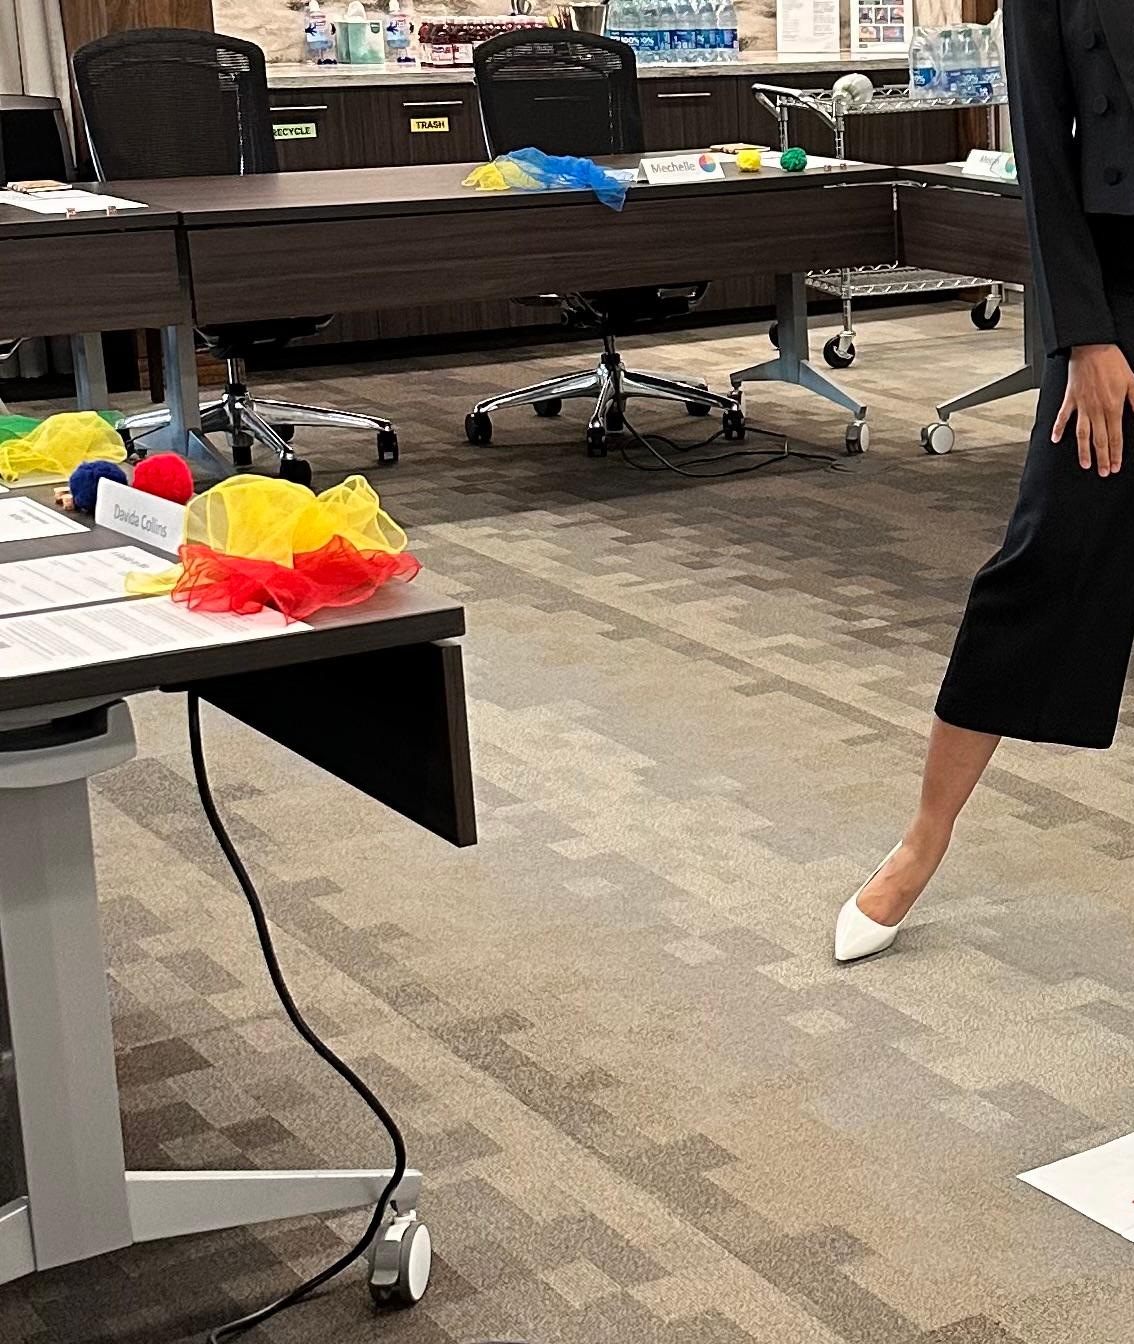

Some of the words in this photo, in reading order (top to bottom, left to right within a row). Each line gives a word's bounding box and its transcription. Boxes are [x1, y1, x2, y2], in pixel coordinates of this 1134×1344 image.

[415, 120, 445, 130] TRASH
[651, 161, 696, 173] Mechelle
[114, 503, 139, 527] Davida
[141, 514, 167, 538] Collins
